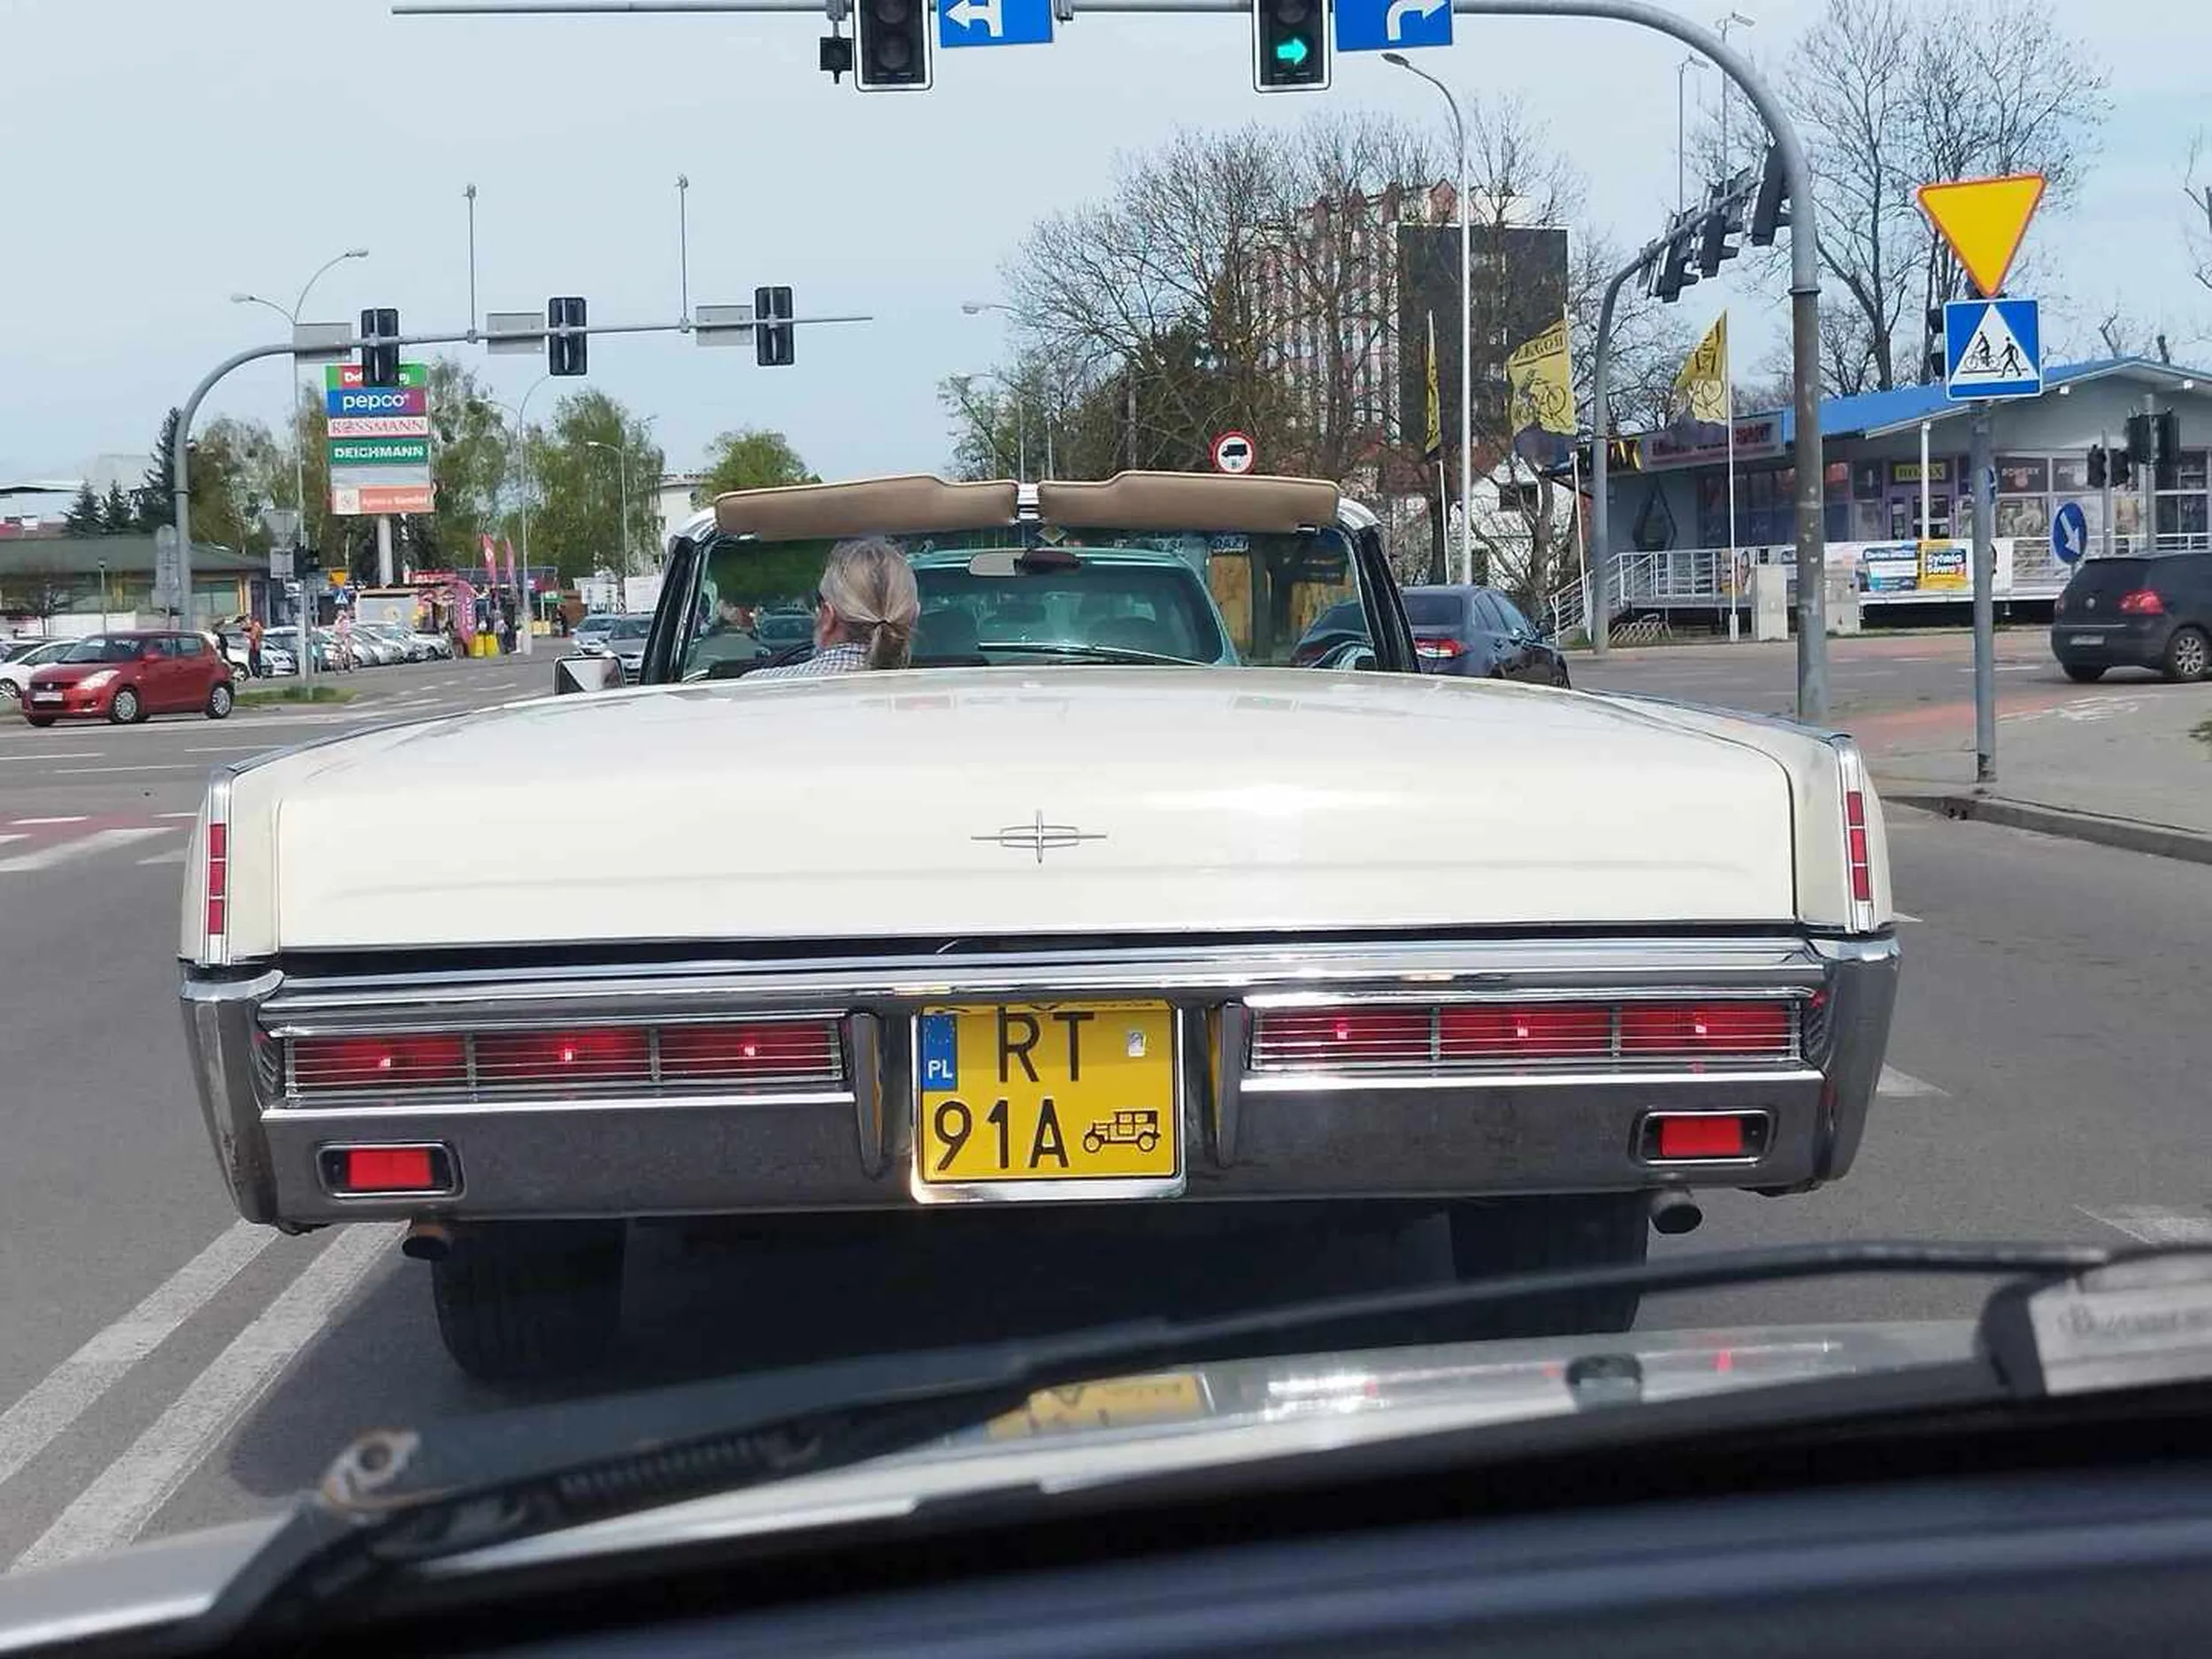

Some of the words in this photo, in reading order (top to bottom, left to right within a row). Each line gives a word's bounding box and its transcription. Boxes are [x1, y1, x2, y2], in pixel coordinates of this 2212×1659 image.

[343, 395, 404, 411] pepco
[334, 445, 423, 458] DEICHMANN
[999, 1007, 1094, 1082] RT
[927, 1059, 954, 1079] PL
[934, 1099, 1069, 1171] 91A
